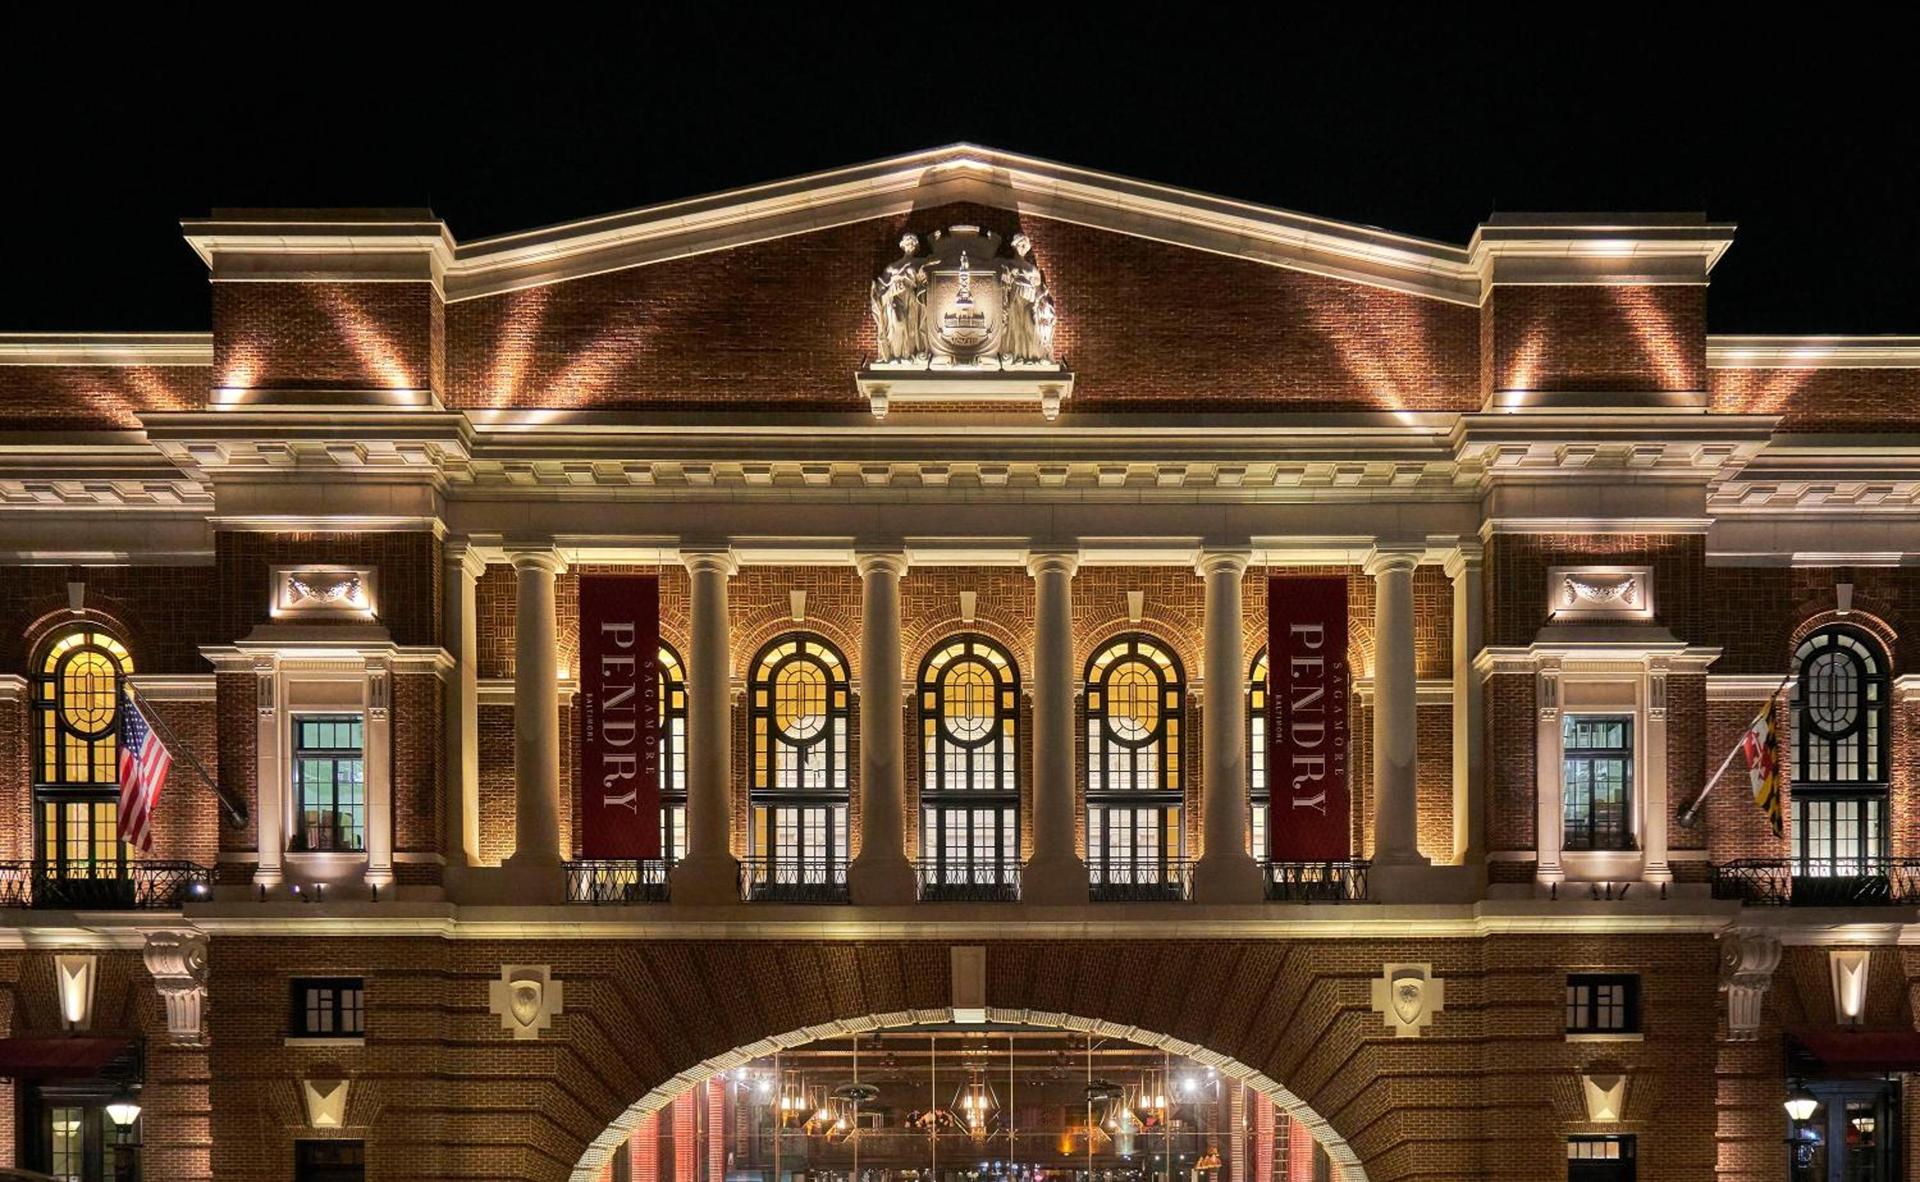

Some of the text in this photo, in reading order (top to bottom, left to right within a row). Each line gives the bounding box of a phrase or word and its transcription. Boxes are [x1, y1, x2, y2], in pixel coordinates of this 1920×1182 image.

[602, 621, 636, 815] PENDRY
[644, 661, 655, 775] SAGAMORE
[1275, 694, 1283, 744] BALTIMORE
[1291, 622, 1326, 816] PENDRY
[1334, 663, 1345, 777] SAGAMORE
